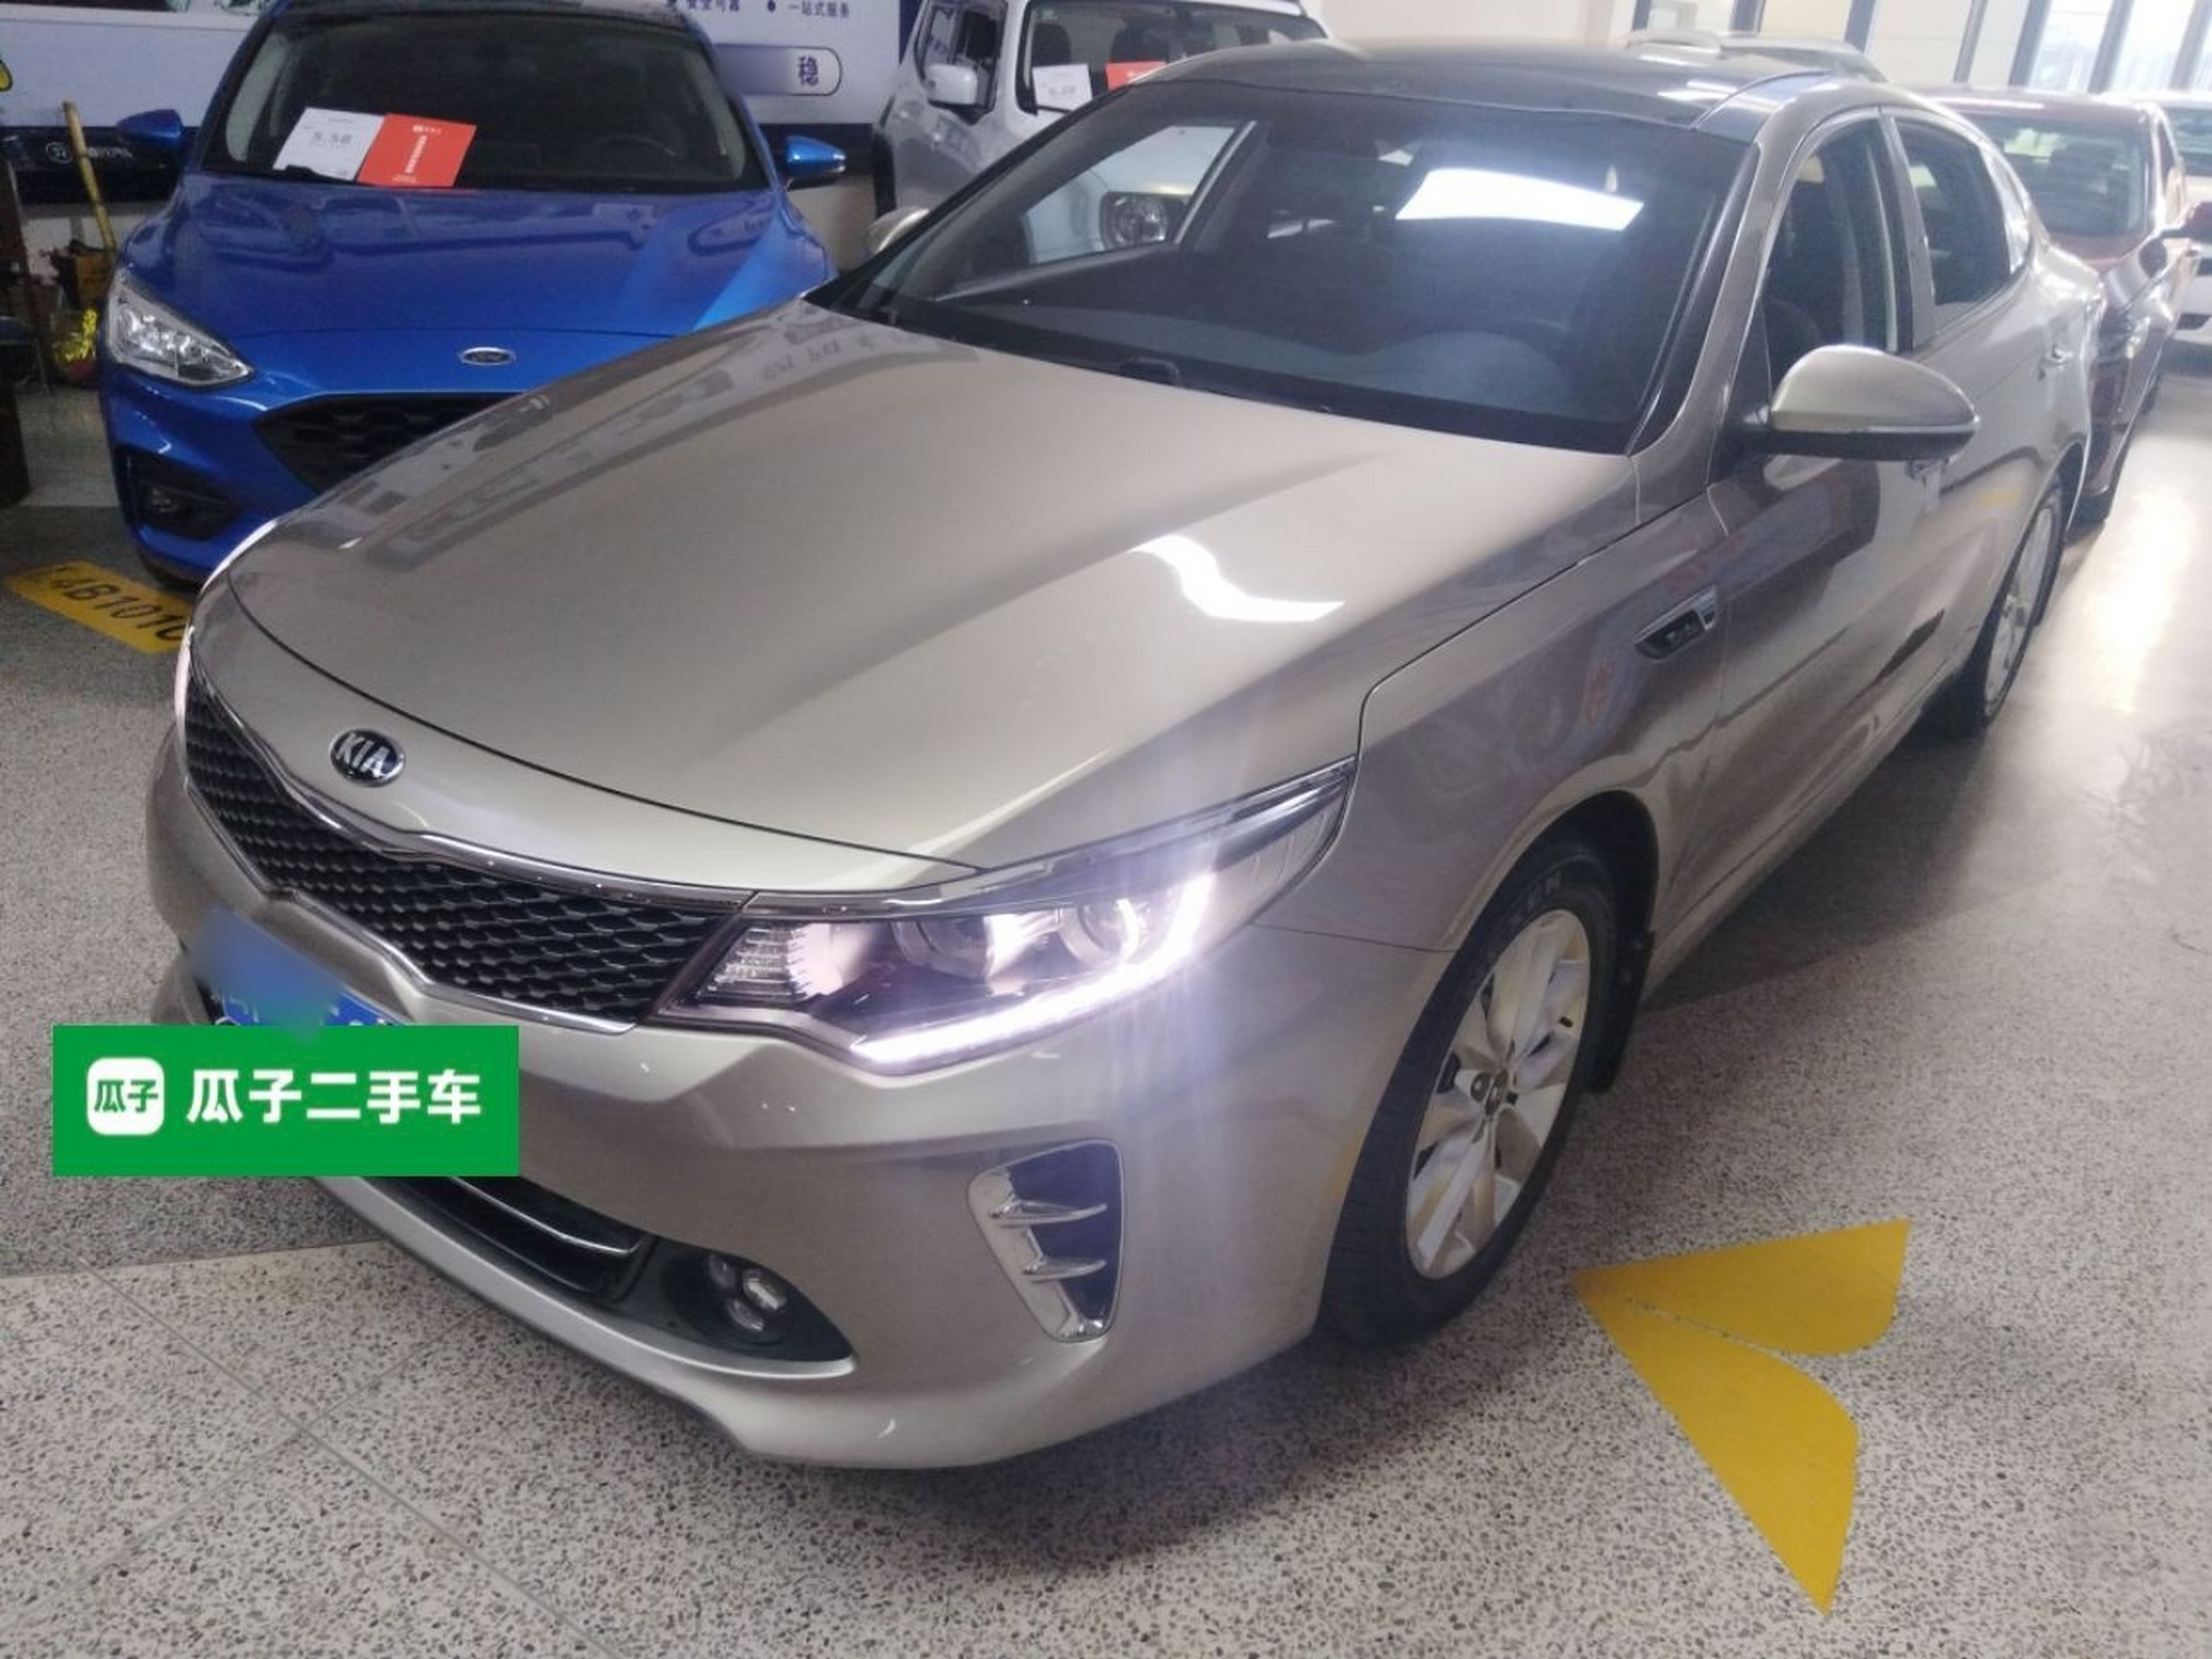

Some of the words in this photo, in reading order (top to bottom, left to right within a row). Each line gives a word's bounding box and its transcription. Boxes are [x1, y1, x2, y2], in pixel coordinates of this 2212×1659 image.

[787, 1, 850, 18] 一站式服务
[797, 55, 819, 86] 稳
[335, 732, 390, 778] KIA
